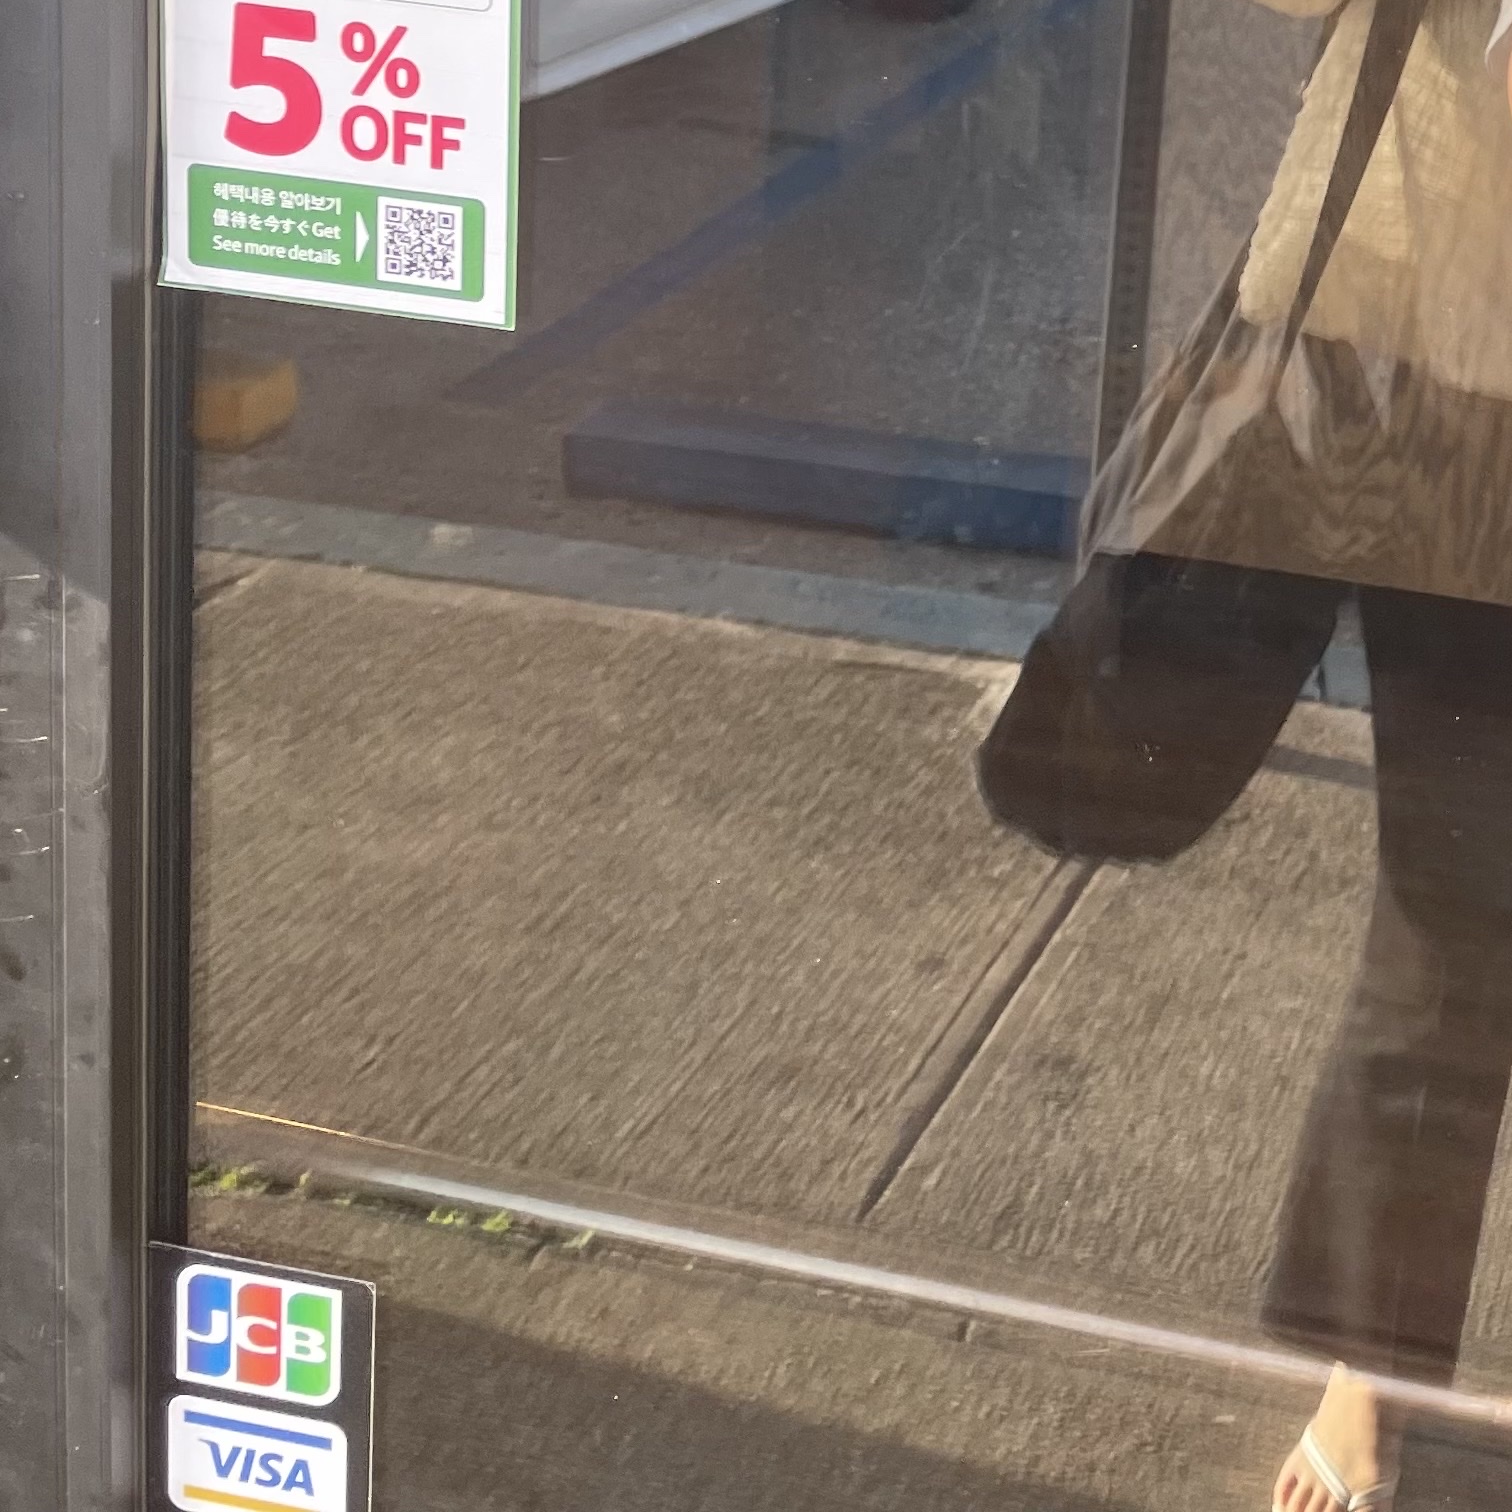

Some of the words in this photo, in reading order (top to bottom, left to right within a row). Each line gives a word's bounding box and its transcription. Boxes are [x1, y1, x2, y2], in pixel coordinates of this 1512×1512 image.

[340, 104, 466, 170] OFF
[279, 190, 342, 216] 알아보기
[212, 208, 310, 237] 優待を今すぐ
[311, 222, 342, 240] Get
[212, 234, 242, 253] See
[244, 241, 287, 259] more
[288, 244, 342, 266] details
[198, 1437, 315, 1497] VISA
